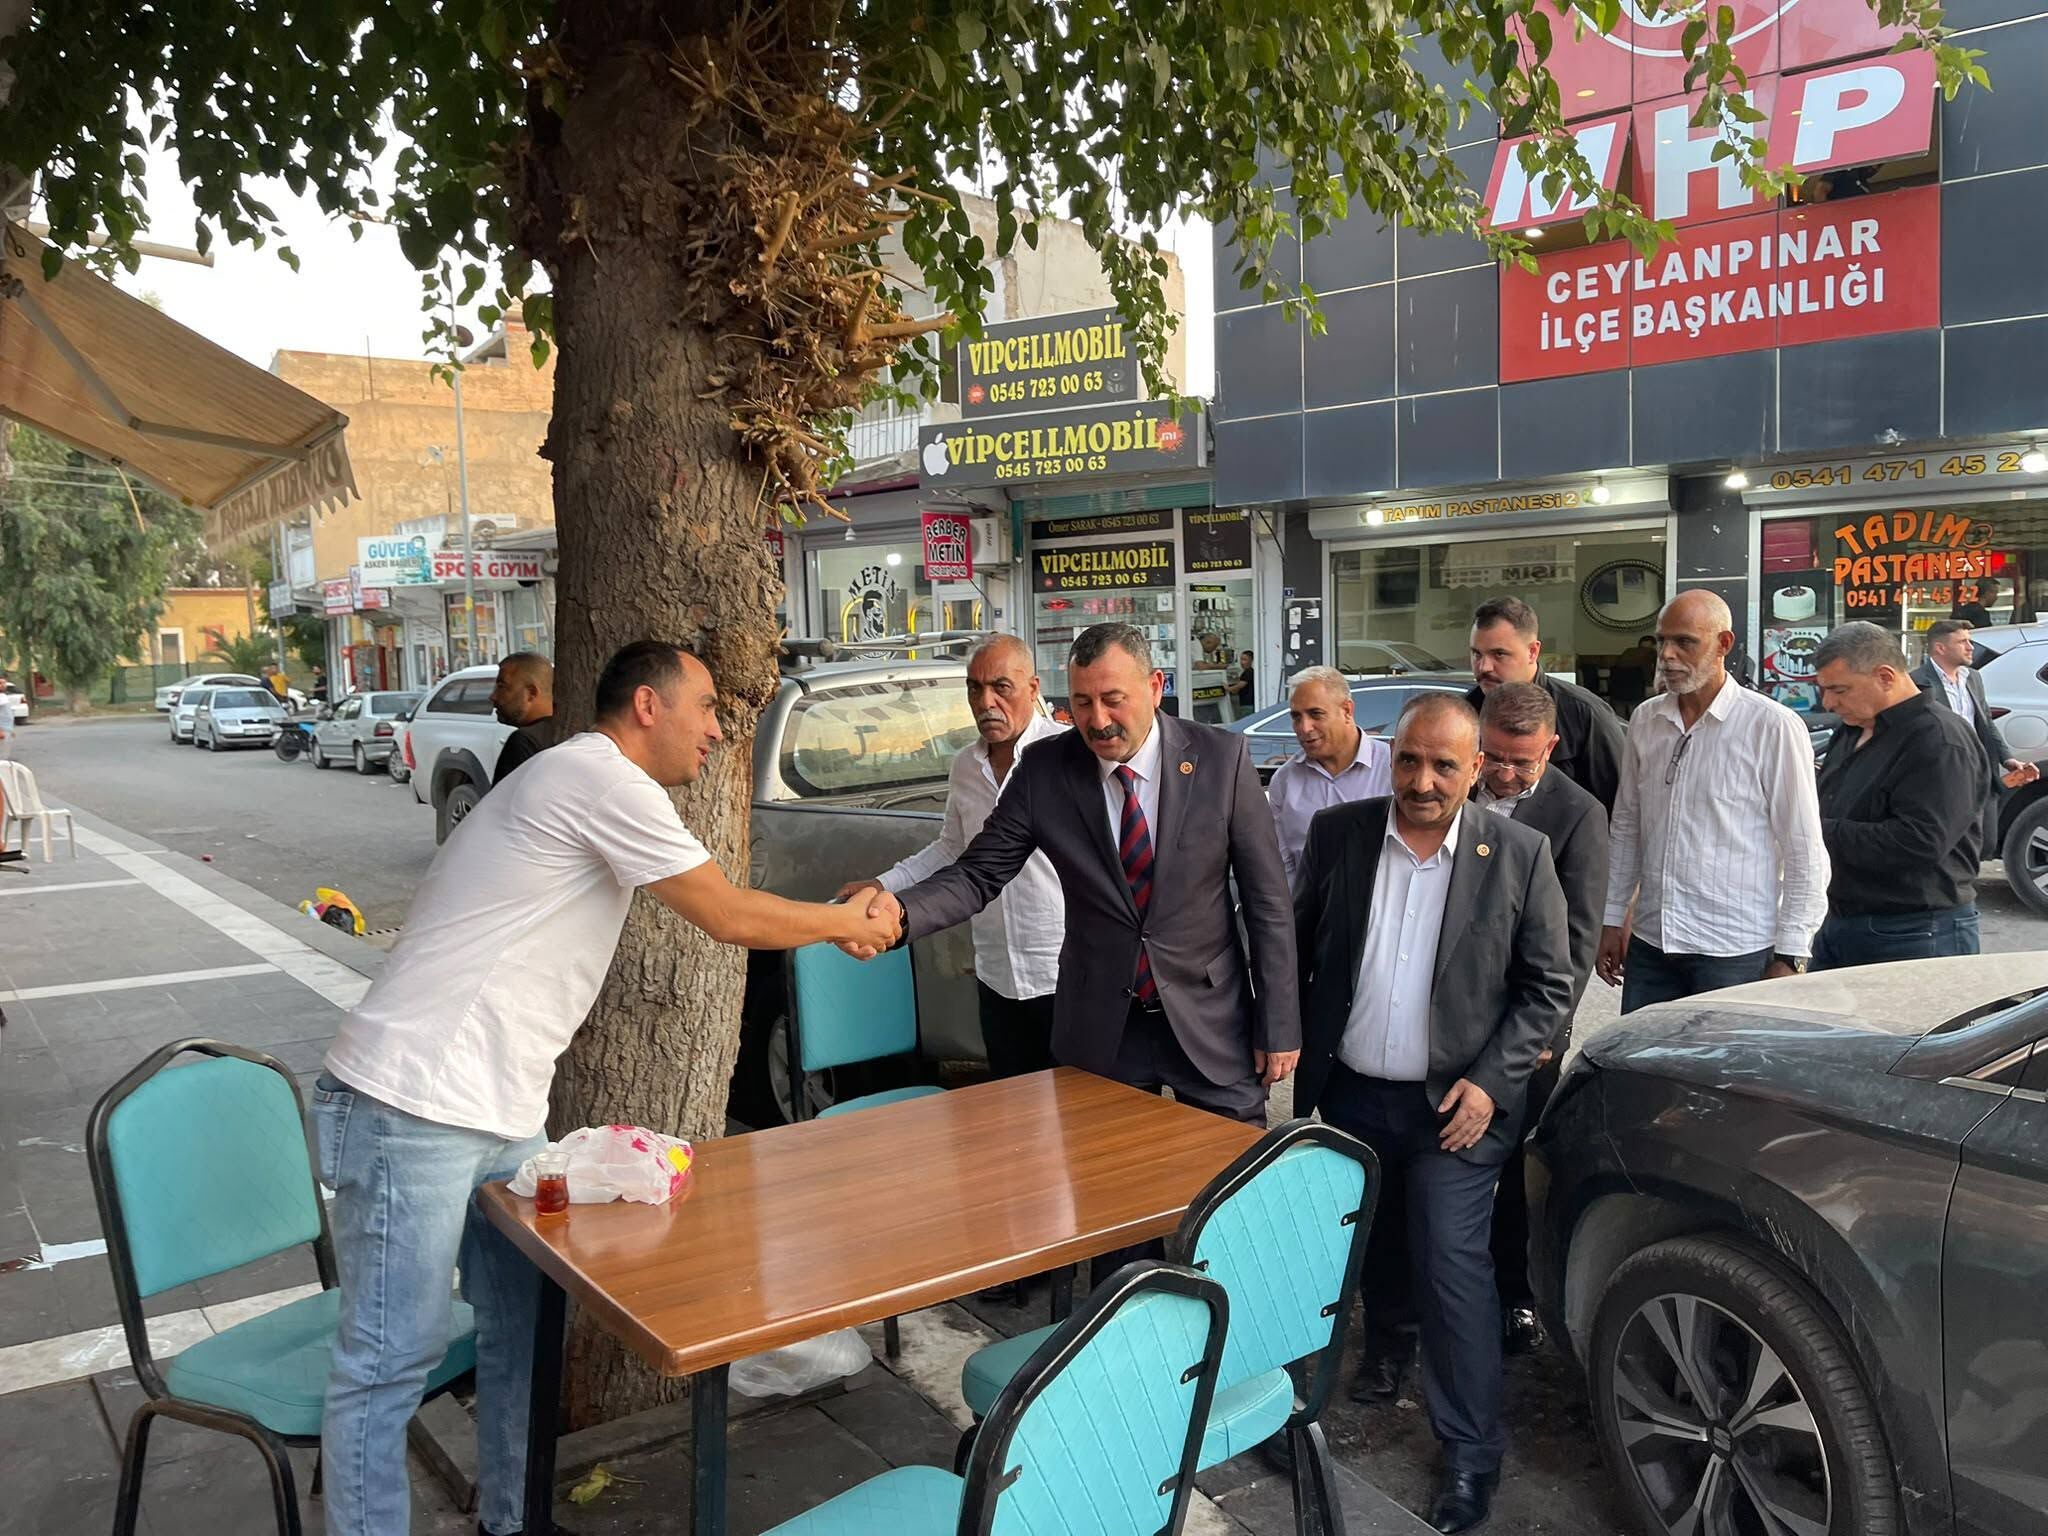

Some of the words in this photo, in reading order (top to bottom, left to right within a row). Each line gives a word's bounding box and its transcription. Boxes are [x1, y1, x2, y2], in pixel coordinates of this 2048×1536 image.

[1491, 65, 1906, 226] MHP
[1546, 218, 1881, 305] CEYLANPINAR
[1540, 305, 1621, 354] İLÇE
[1632, 263, 1884, 339] BAŞKANLIĞI
[968, 313, 1126, 376] VİPCELLMOBİL
[989, 380, 1025, 403] 0545
[1030, 377, 1057, 398] 723
[1061, 374, 1079, 394] 00
[1083, 371, 1103, 392] 63
[946, 410, 1163, 465] VİPCELLMOBİL
[996, 460, 1030, 479] 0545
[1035, 458, 1062, 476] 723
[1065, 456, 1084, 473] 00
[1087, 455, 1107, 471] 63
[1771, 466, 1851, 490] 0541
[1863, 459, 1926, 481] 471
[1940, 455, 1985, 476] 45
[1997, 452, 2023, 472] 2
[1383, 503, 1441, 523] TADIM
[925, 519, 967, 543] BERBER
[1834, 511, 1972, 555] TADIM
[1040, 542, 1169, 574] VİPCELLMOBİL
[1060, 575, 1089, 588] 0545
[1092, 574, 1113, 586] 723
[1115, 573, 1130, 585] 00
[1133, 572, 1148, 584] 63
[1847, 588, 1887, 608] 0541
[1932, 585, 1951, 604] 45
[1958, 584, 1979, 604] 22
